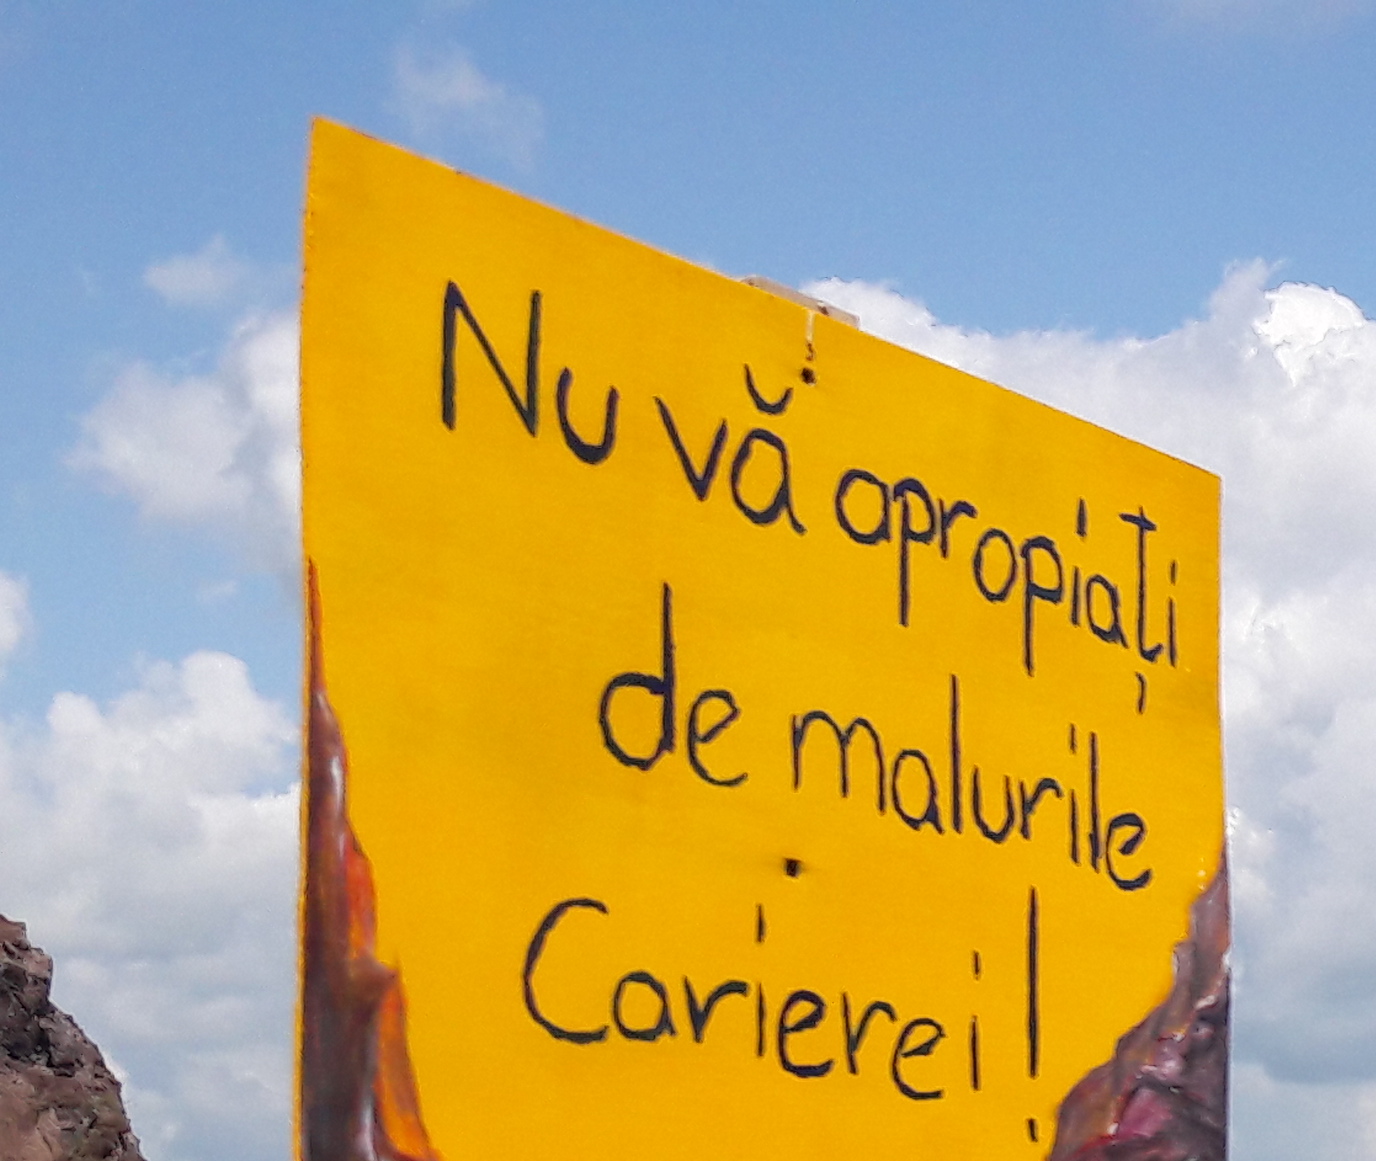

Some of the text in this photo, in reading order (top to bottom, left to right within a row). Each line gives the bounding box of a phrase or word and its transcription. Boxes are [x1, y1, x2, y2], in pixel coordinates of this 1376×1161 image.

[440, 281, 618, 466] Nu
[654, 363, 806, 536] vă
[597, 581, 1153, 893] de malurile
